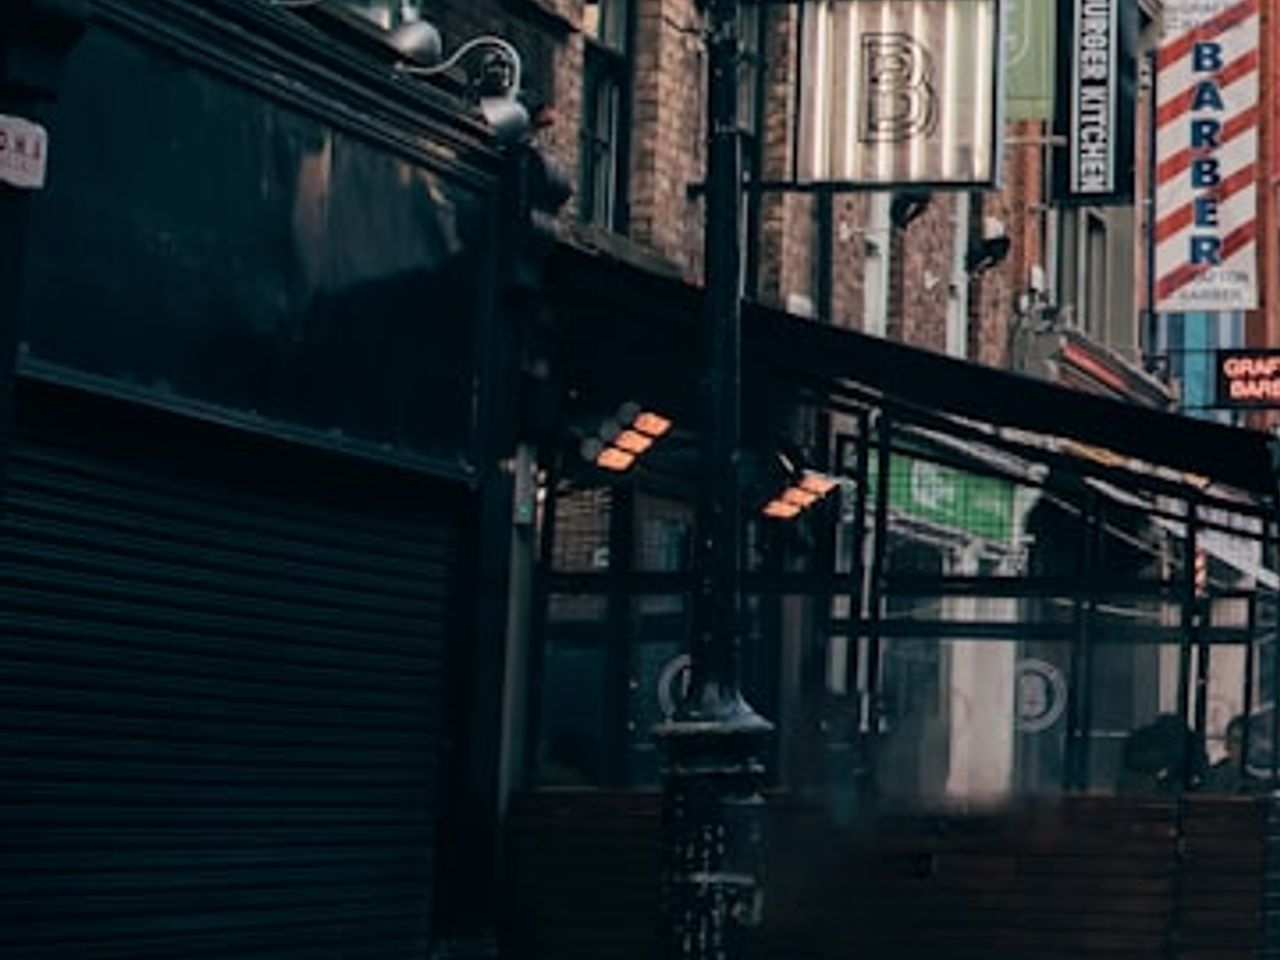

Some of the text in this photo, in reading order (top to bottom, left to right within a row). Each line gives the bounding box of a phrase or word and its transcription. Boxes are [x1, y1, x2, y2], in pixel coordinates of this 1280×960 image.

[857, 32, 940, 144] B
[1079, 88, 1108, 193] KITCHEN
[1190, 42, 1224, 266] BARBER
